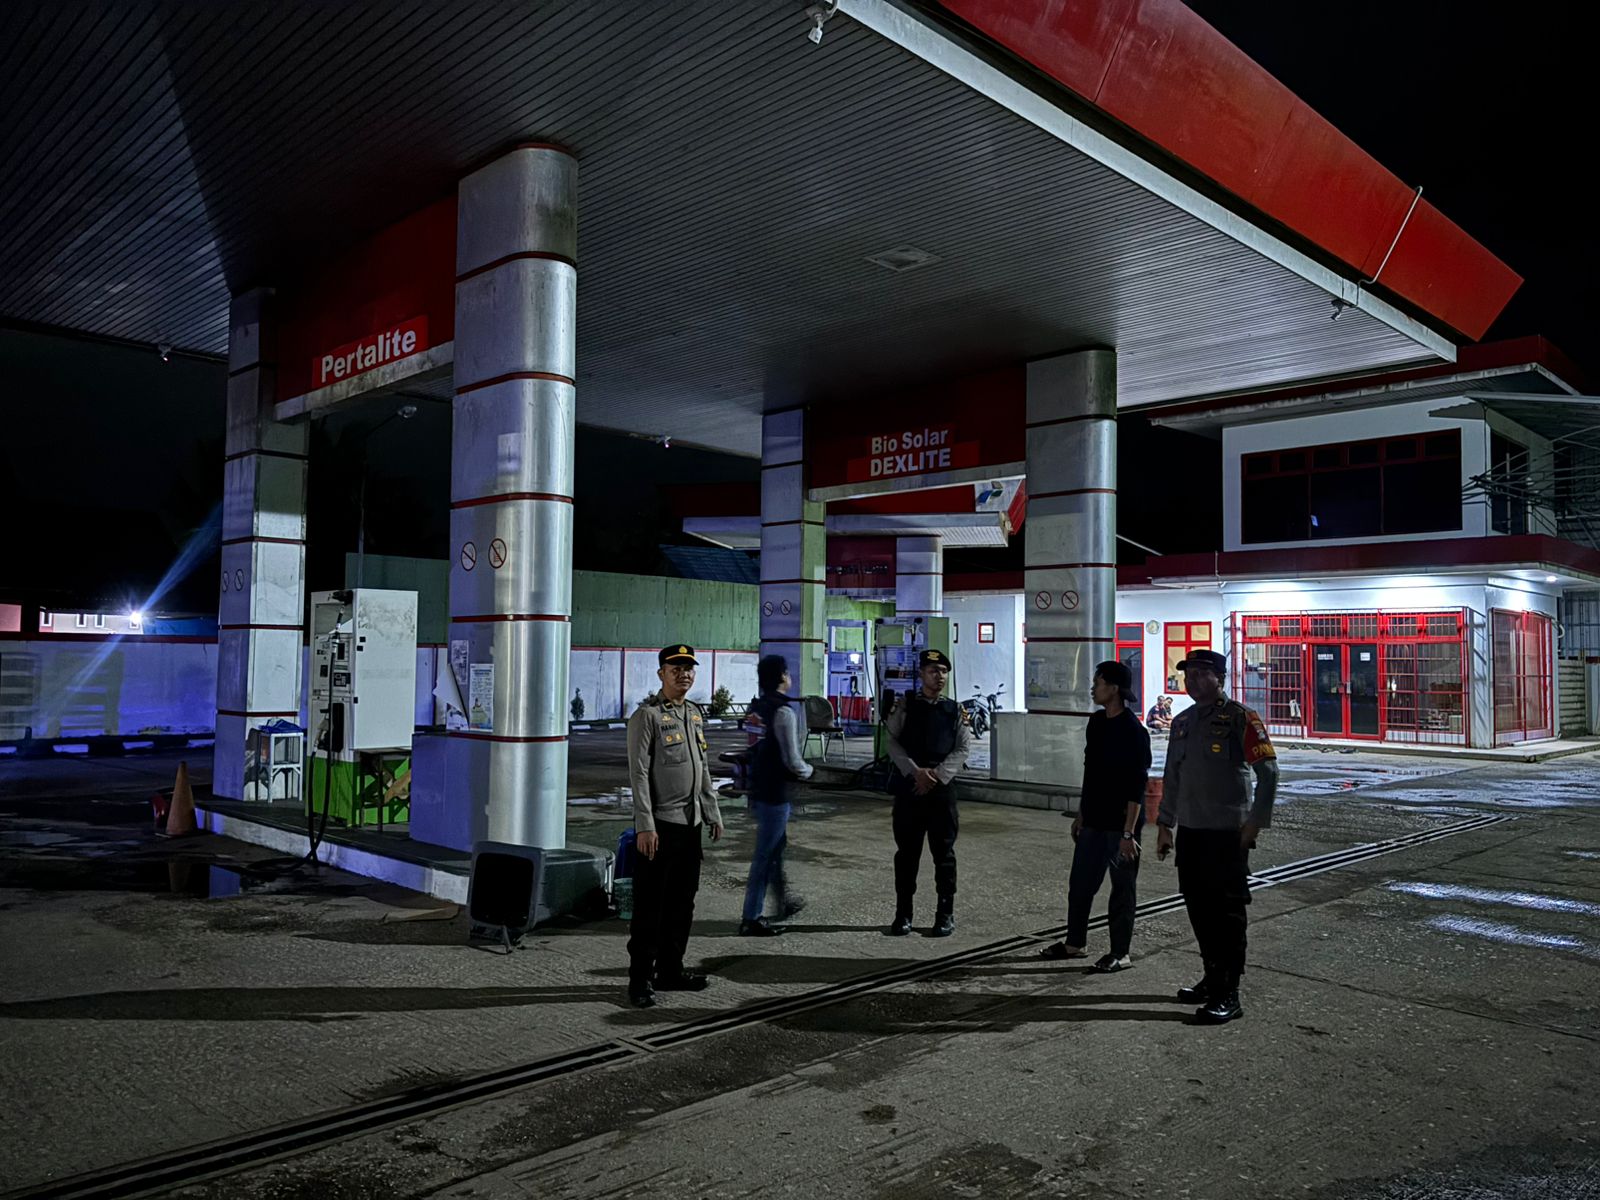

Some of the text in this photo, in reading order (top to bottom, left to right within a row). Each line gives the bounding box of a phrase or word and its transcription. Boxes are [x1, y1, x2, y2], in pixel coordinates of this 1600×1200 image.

[321, 328, 417, 383] Pertalite
[871, 427, 949, 456] Bio Solar
[870, 447, 952, 477] DEXLITE
